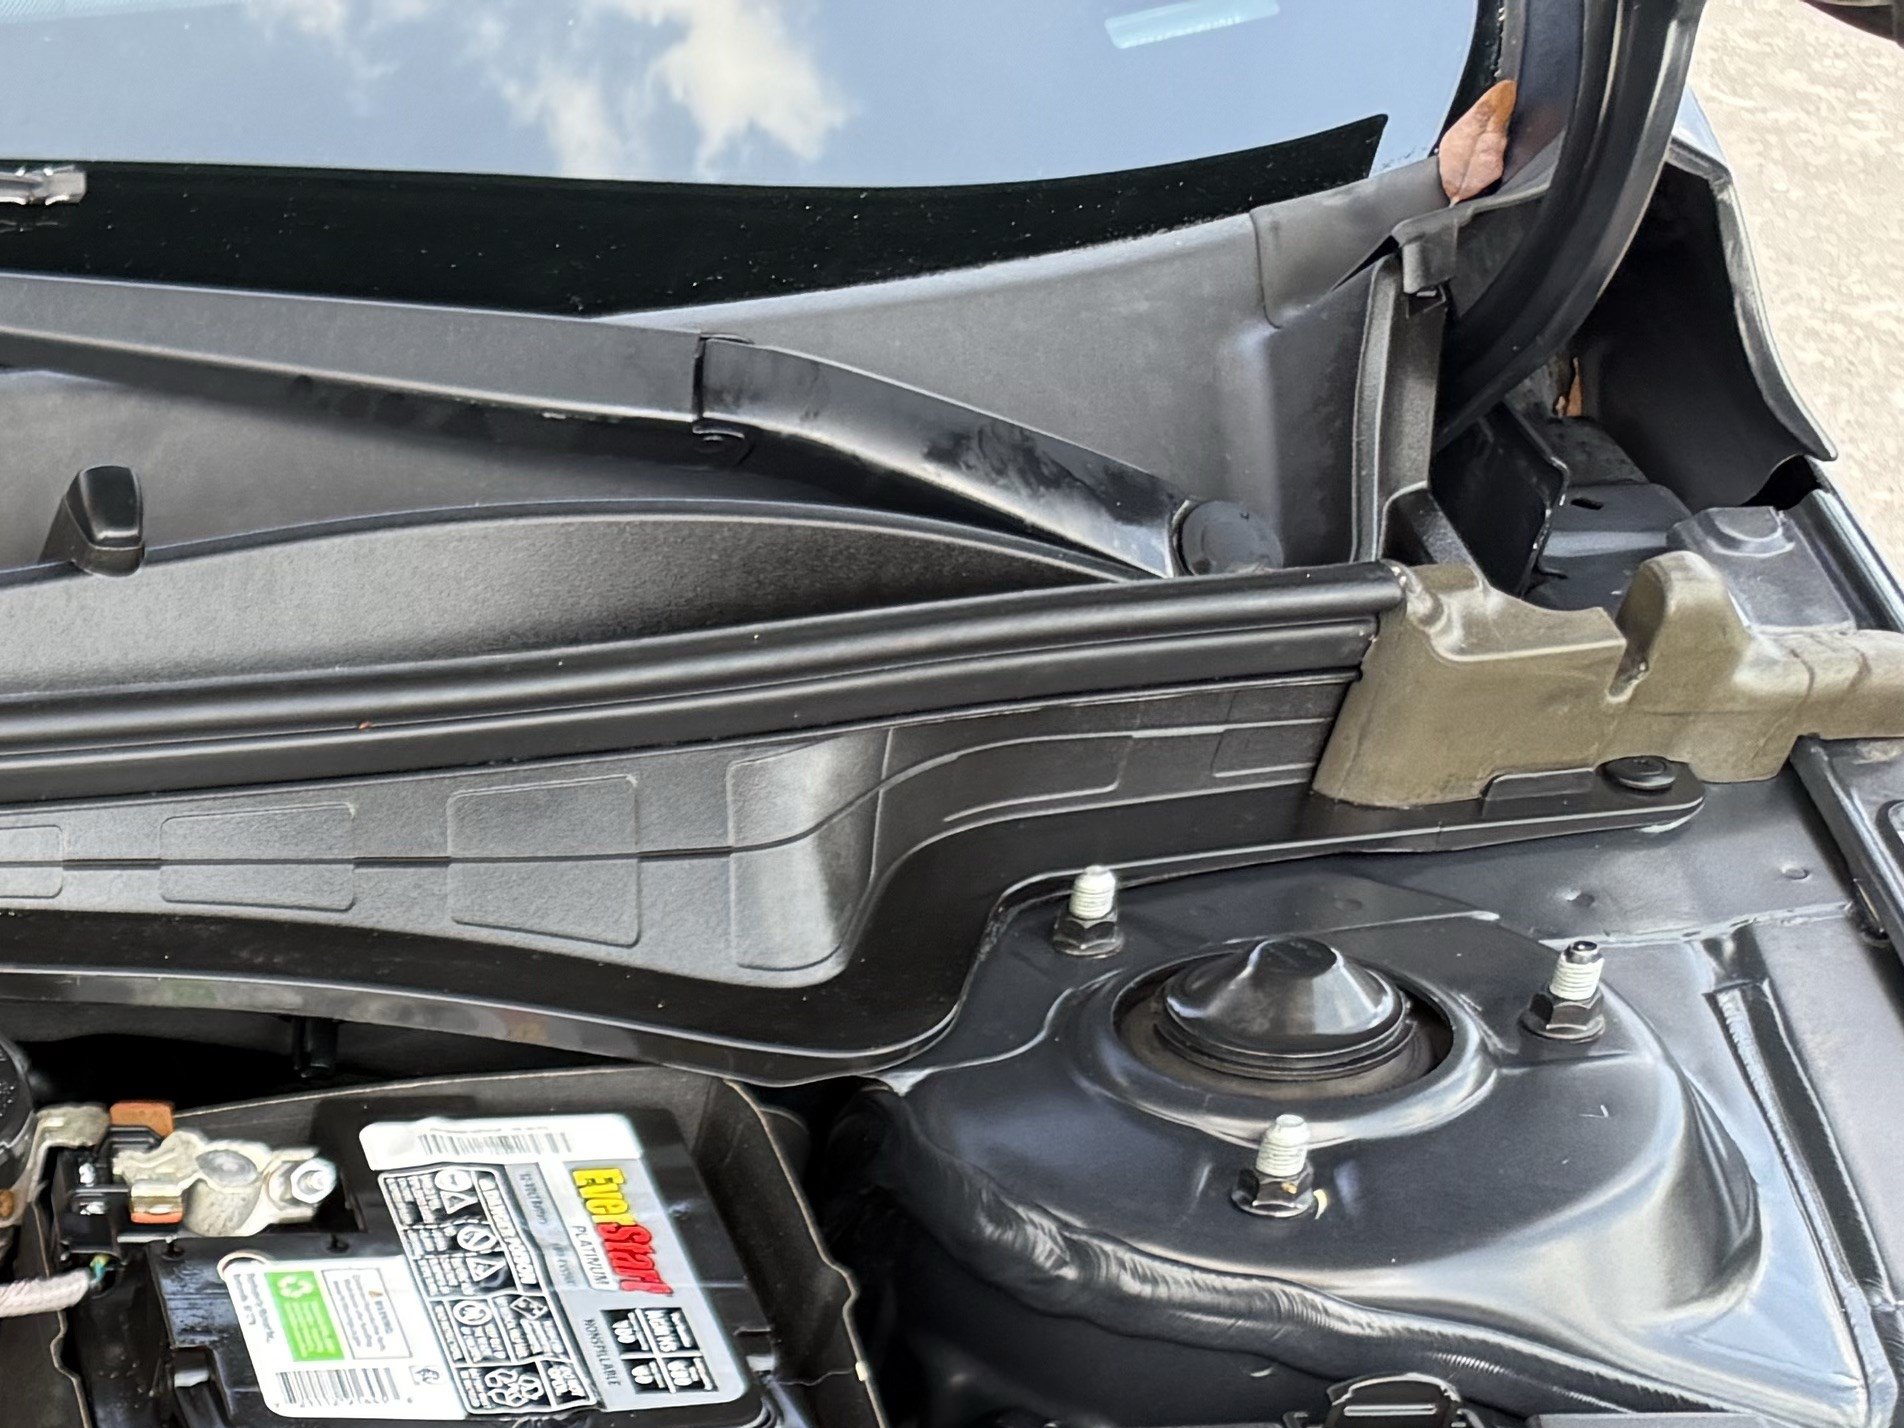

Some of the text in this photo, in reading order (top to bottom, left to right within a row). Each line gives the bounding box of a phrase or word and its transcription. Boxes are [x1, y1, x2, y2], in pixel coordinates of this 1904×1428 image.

[571, 1225, 610, 1287] PLATINUM
[572, 1167, 673, 1297] EverStart
[583, 1318, 623, 1386] NONSPILLABLE
